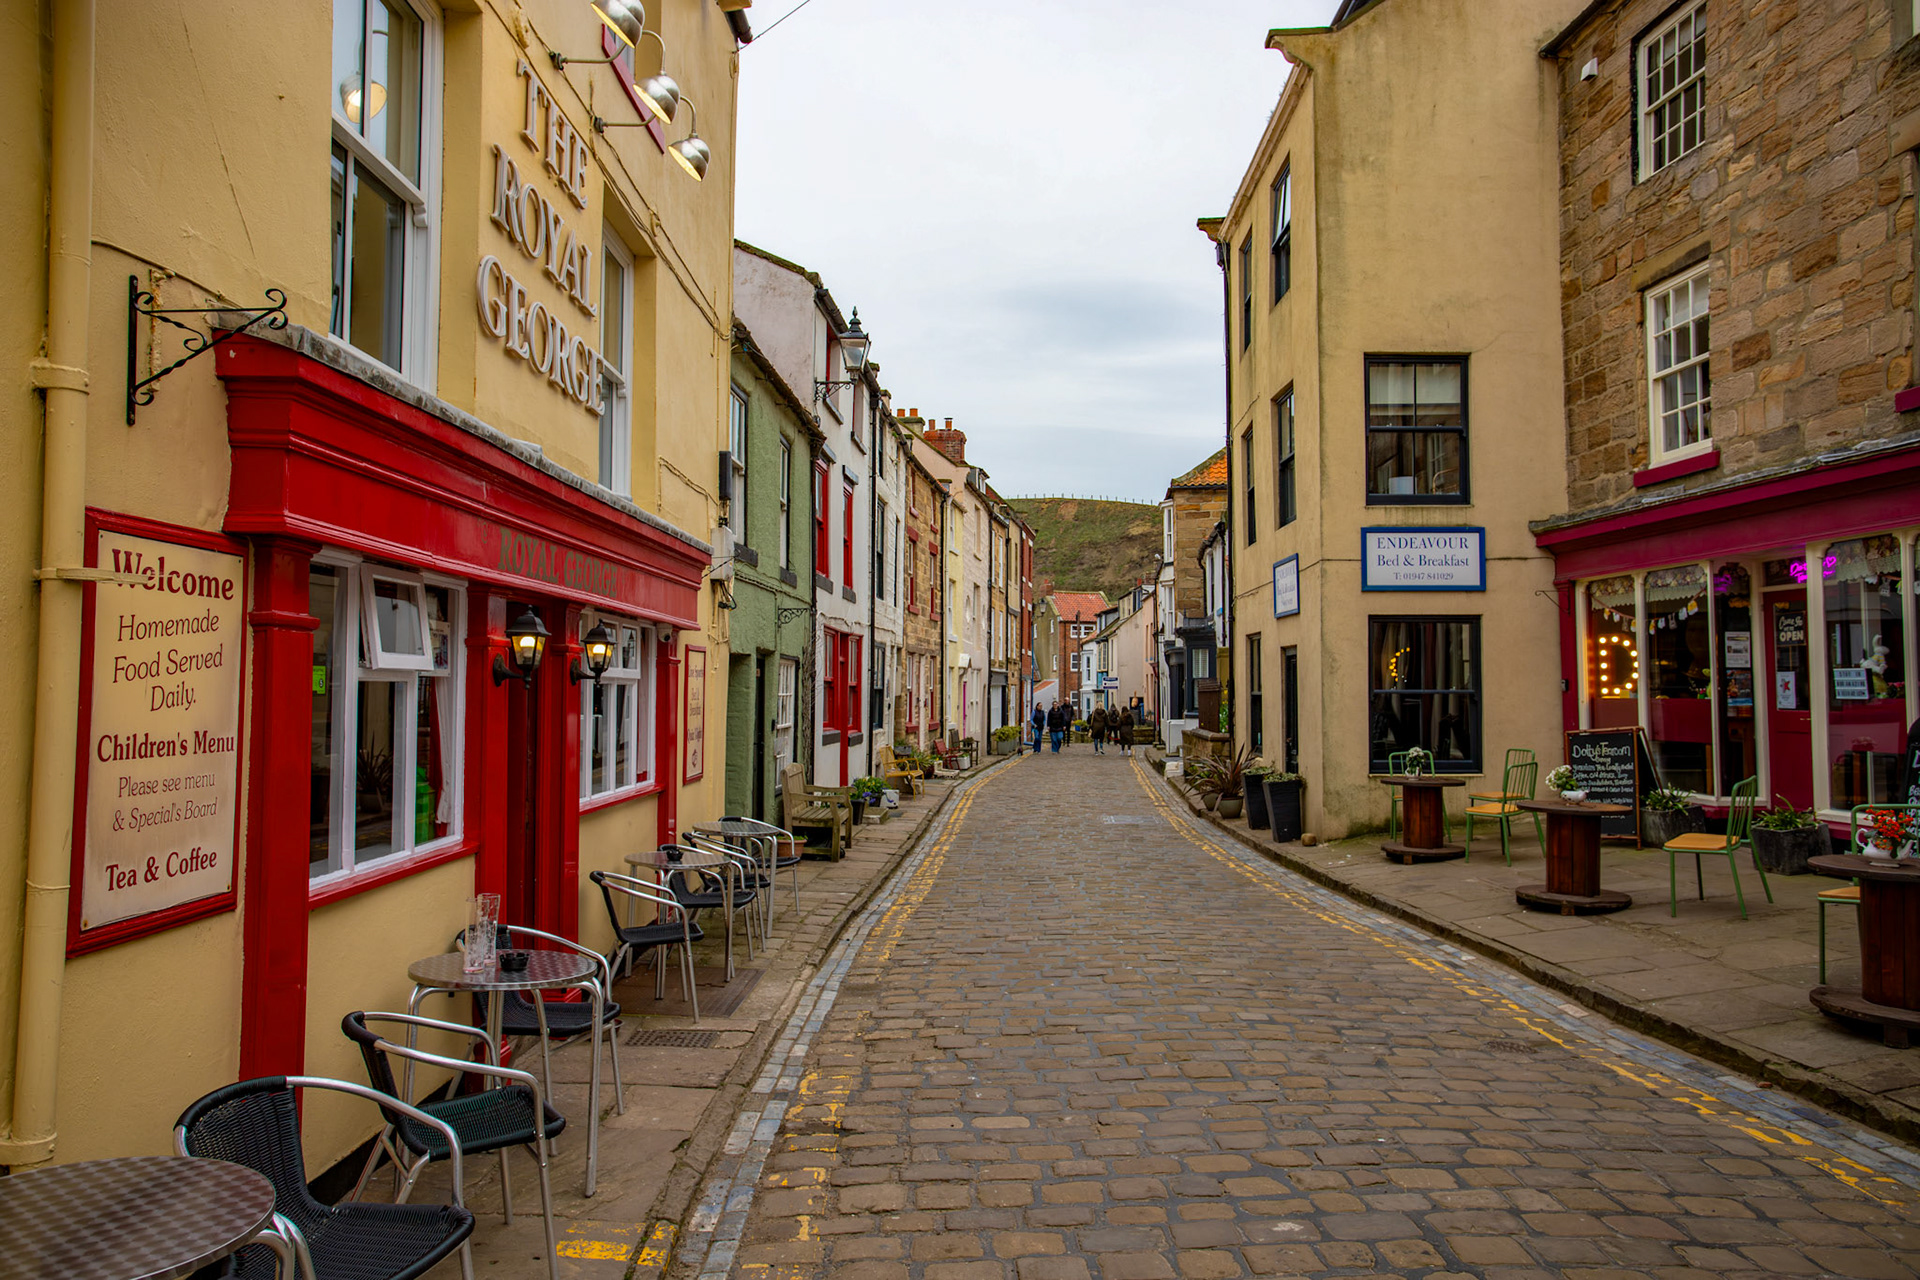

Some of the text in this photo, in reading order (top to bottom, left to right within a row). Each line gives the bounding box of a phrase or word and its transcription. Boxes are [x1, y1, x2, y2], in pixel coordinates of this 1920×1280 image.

[517, 58, 589, 210] THE
[490, 142, 598, 318] ROYAL
[476, 254, 606, 416] GEORGE
[1377, 536, 1470, 550] ENDEAVOUR
[1377, 554, 1470, 567] Bed & Breakfast
[112, 548, 234, 601] Welcome
[498, 528, 560, 584] ROYAL
[564, 550, 618, 598] GEORGE
[1403, 572, 1426, 581] 01947
[117, 607, 220, 642] Homemade
[1779, 630, 1804, 642] OPEN
[112, 642, 223, 684] Food Served
[149, 681, 197, 712] Daily.
[97, 730, 235, 763] Children's Menu
[118, 773, 216, 798] Please see menu
[112, 796, 218, 832] & Special's Board
[105, 846, 218, 892] Tea & Coffee
